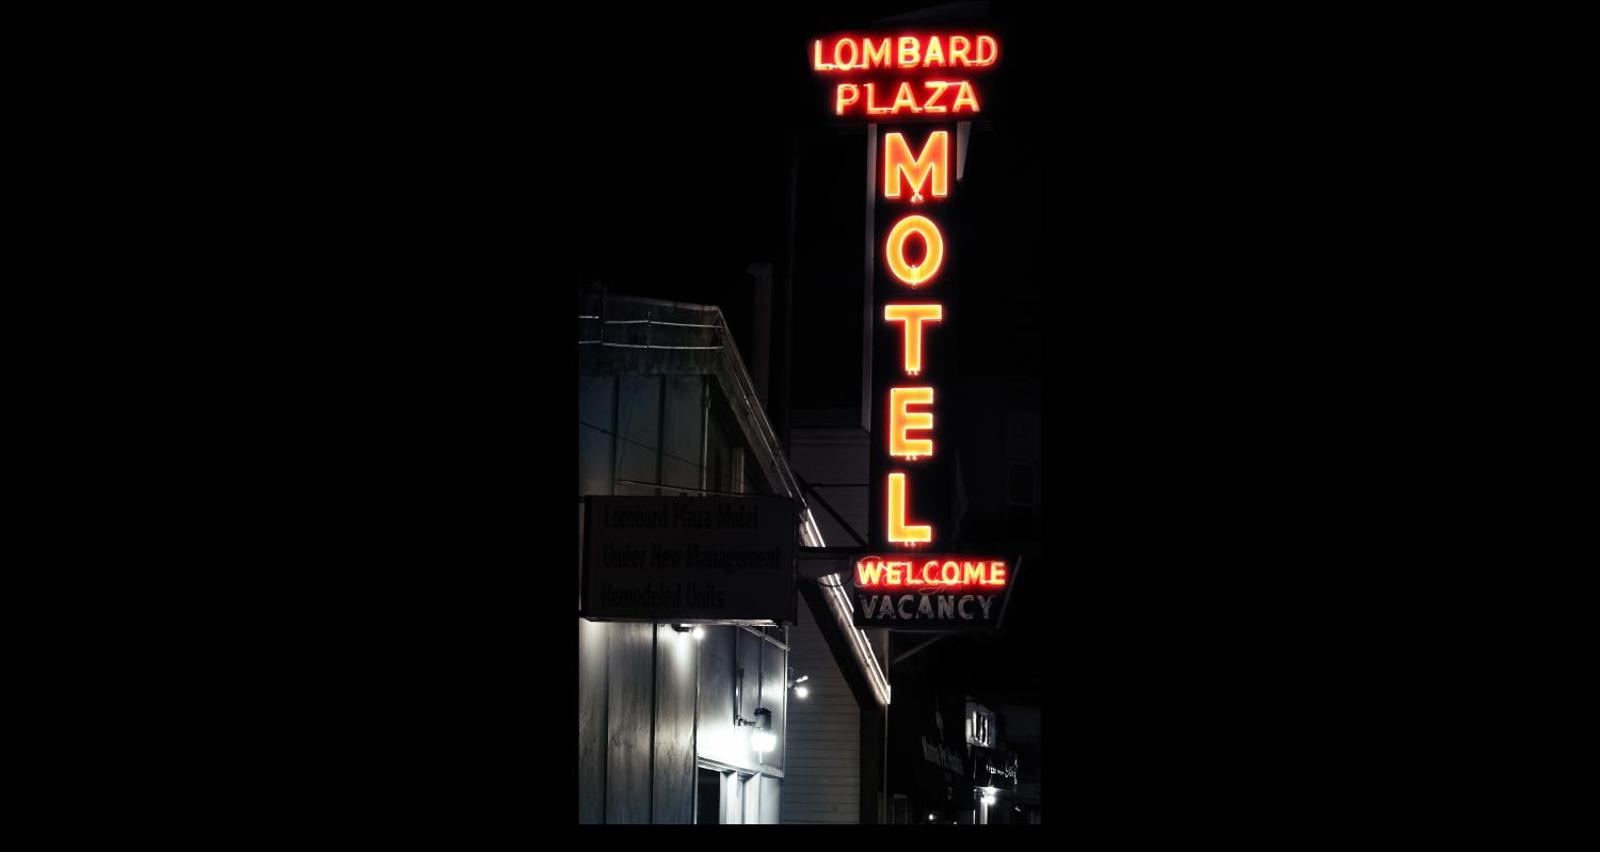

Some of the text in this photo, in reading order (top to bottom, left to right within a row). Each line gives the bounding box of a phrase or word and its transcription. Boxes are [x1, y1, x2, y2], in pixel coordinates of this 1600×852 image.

[813, 36, 998, 71] LOMBARD
[835, 81, 980, 116] PLAZA
[884, 131, 948, 543] MOTEL
[604, 502, 759, 529] Lombard Plaza Motel
[602, 543, 782, 574] Under New Management
[856, 560, 1007, 586] WELCOME
[600, 581, 725, 609] Remodeled Units
[859, 594, 995, 621] VACANCY
